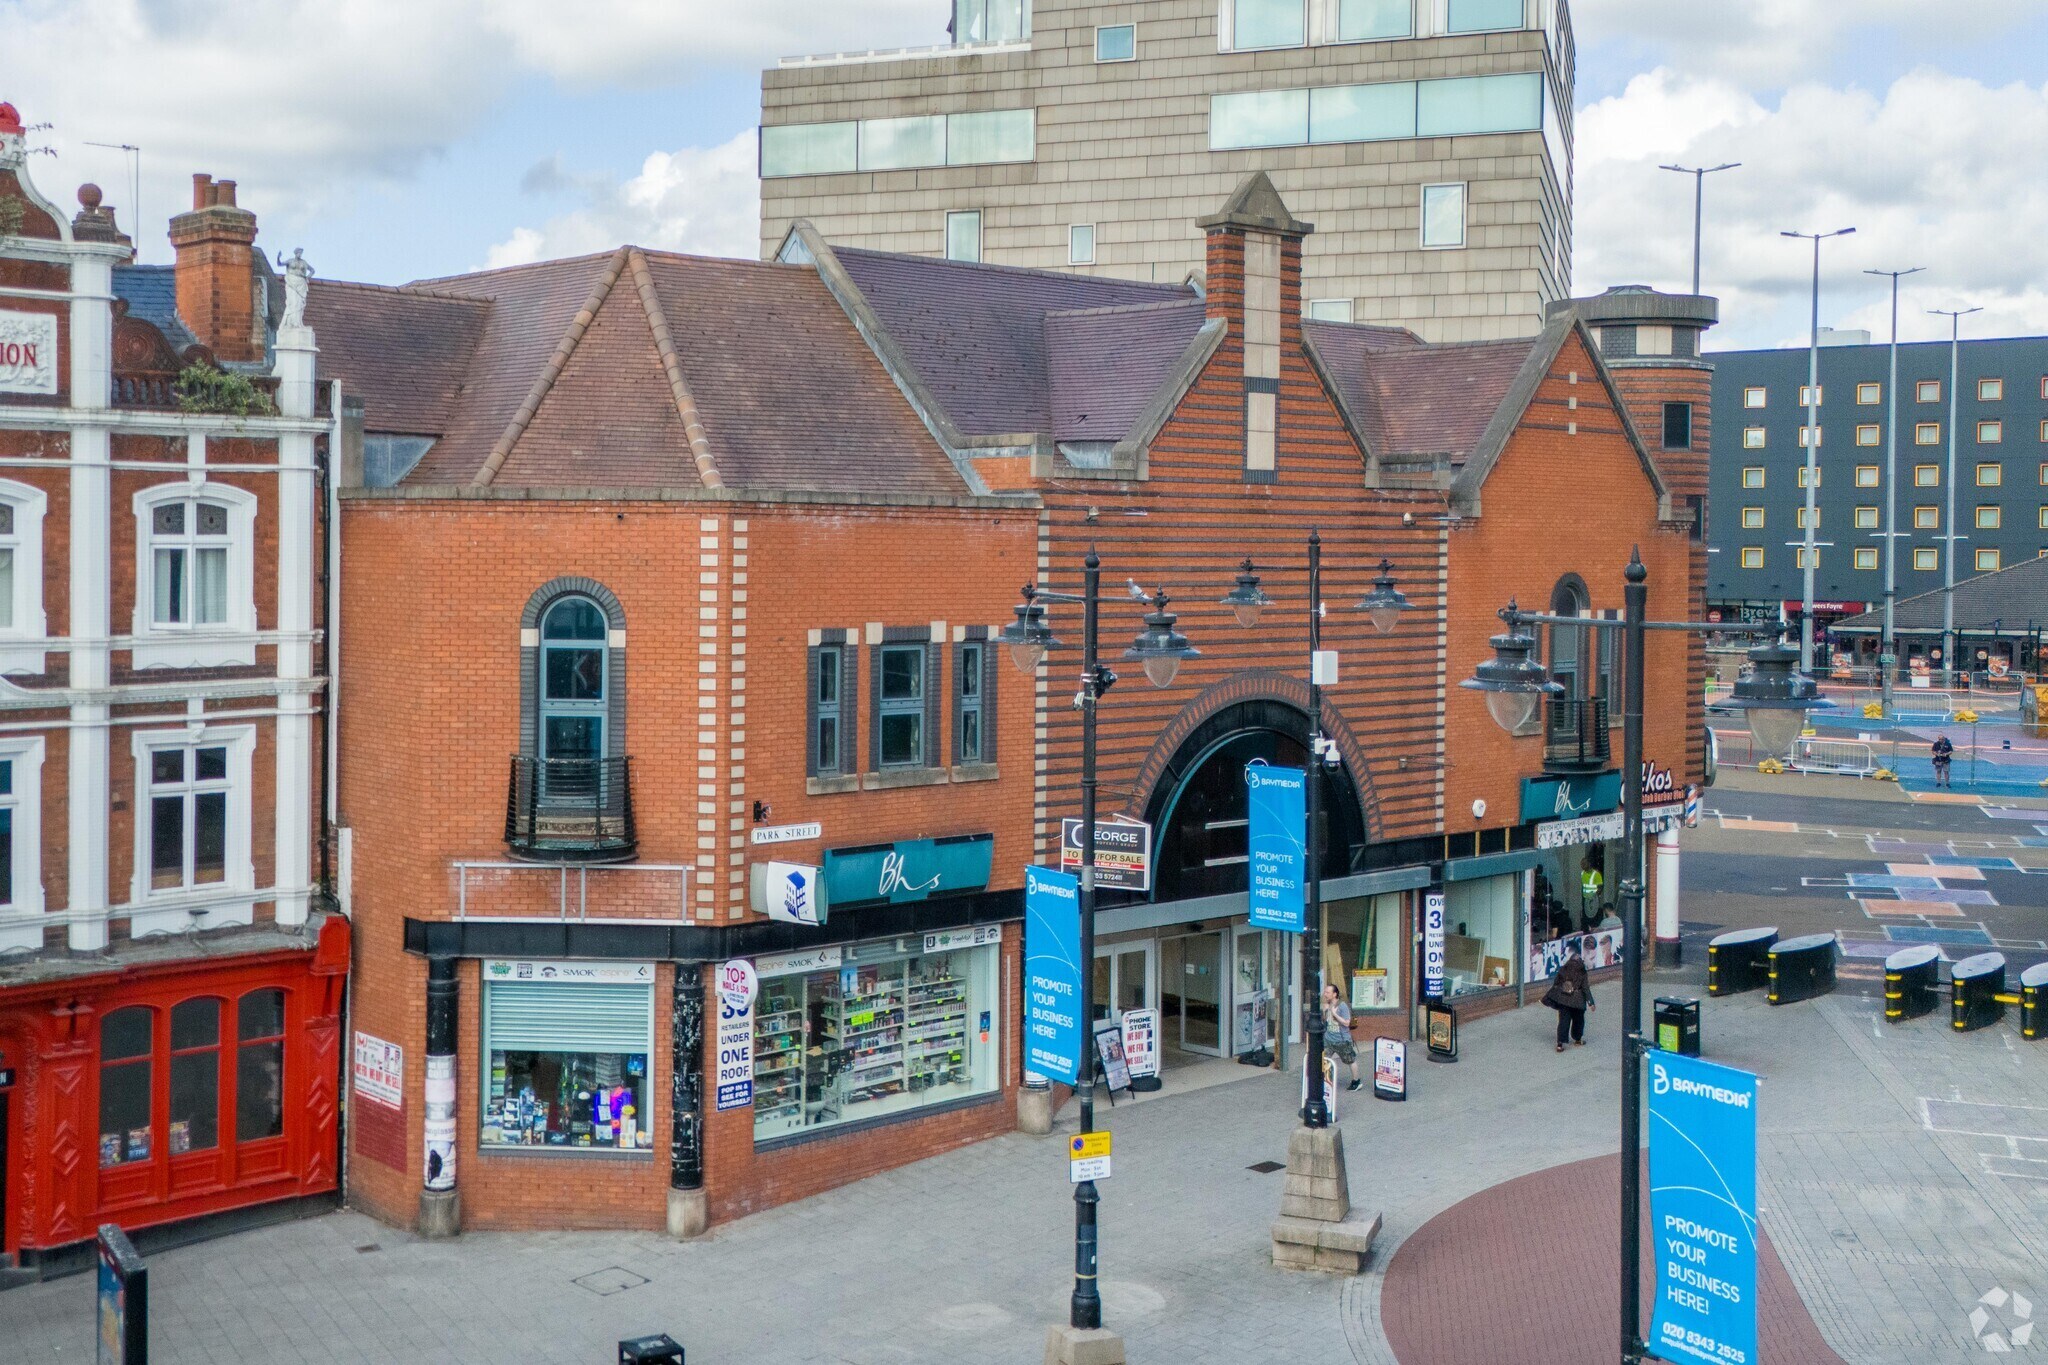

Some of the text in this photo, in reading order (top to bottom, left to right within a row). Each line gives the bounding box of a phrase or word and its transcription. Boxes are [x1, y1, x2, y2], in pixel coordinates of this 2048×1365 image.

[1261, 778, 1300, 788] BAYMEDIA
[1554, 781, 1591, 813] Bhs
[756, 826, 817, 840] PARK STREET
[1120, 854, 1142, 863] SALE
[1256, 851, 1293, 864] PROMOTE
[879, 851, 942, 895] Bhs
[1256, 864, 1278, 874] YOUR
[1256, 876, 1295, 889] BUSINESS
[1038, 882, 1074, 899] BAYMEDIA
[1256, 889, 1279, 899] HERE!
[1429, 898, 1444, 906] OV
[787, 958, 813, 968] SMOK
[563, 968, 595, 976] SMOK
[726, 967, 746, 983] TOP
[722, 981, 735, 991] NAILS
[740, 985, 749, 994] SPA
[1032, 976, 1072, 996] PROMOTE
[1032, 991, 1055, 1007] YOUR
[1032, 1007, 1073, 1028] BUSINESS
[1129, 1016, 1151, 1024] PHONE
[721, 1021, 749, 1031] RETAILERS
[1032, 1023, 1056, 1039] HERE!
[721, 1032, 749, 1045] UNDER
[1127, 1031, 1144, 1041] WE BUY
[1127, 1043, 1144, 1054] WE FIX
[721, 1047, 749, 1064] ONE
[1134, 1056, 1143, 1064] SELL
[721, 1066, 749, 1080] ROOF
[1672, 1077, 1749, 1109] BAYMEDIA
[718, 1096, 751, 1109] YOURSELF
[1665, 1215, 1738, 1254] PROMOTE
[1666, 1238, 1706, 1266] YOUR
[1668, 1261, 1740, 1303] BUSINESS
[1667, 1285, 1709, 1315] HERE!
[1662, 1322, 1745, 1364] 020 8343 2525
